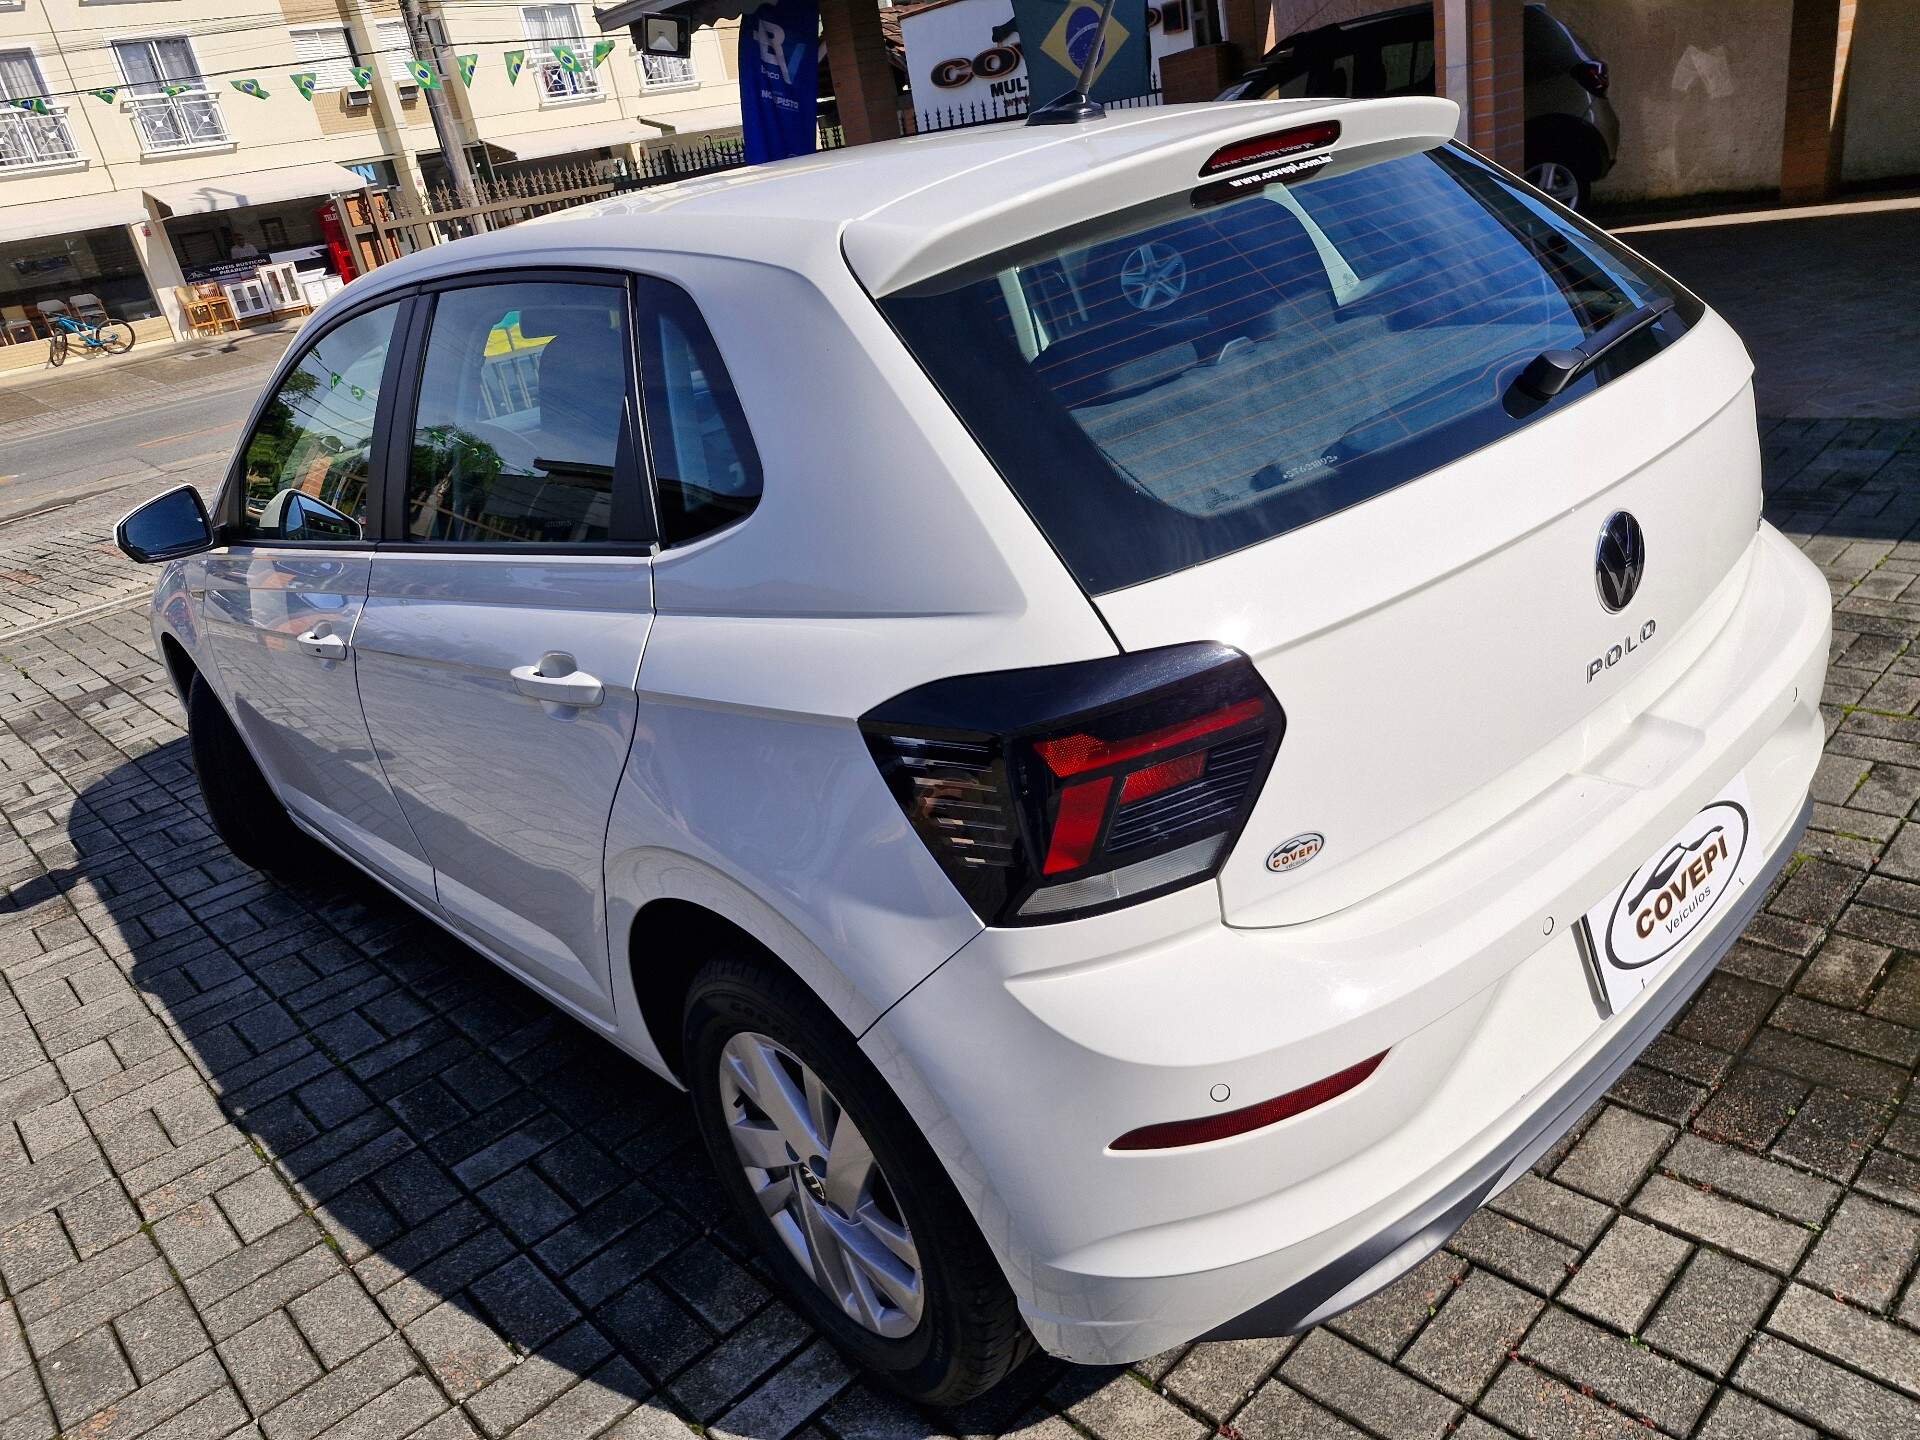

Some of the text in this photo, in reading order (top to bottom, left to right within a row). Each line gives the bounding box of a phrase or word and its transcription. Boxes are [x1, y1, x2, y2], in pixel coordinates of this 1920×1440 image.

[1229, 154, 1333, 187] www.covepi.com.br
[1586, 619, 1656, 684] POLO
[1273, 843, 1317, 868] COVEPI
[1636, 834, 1728, 939] COVEPI
